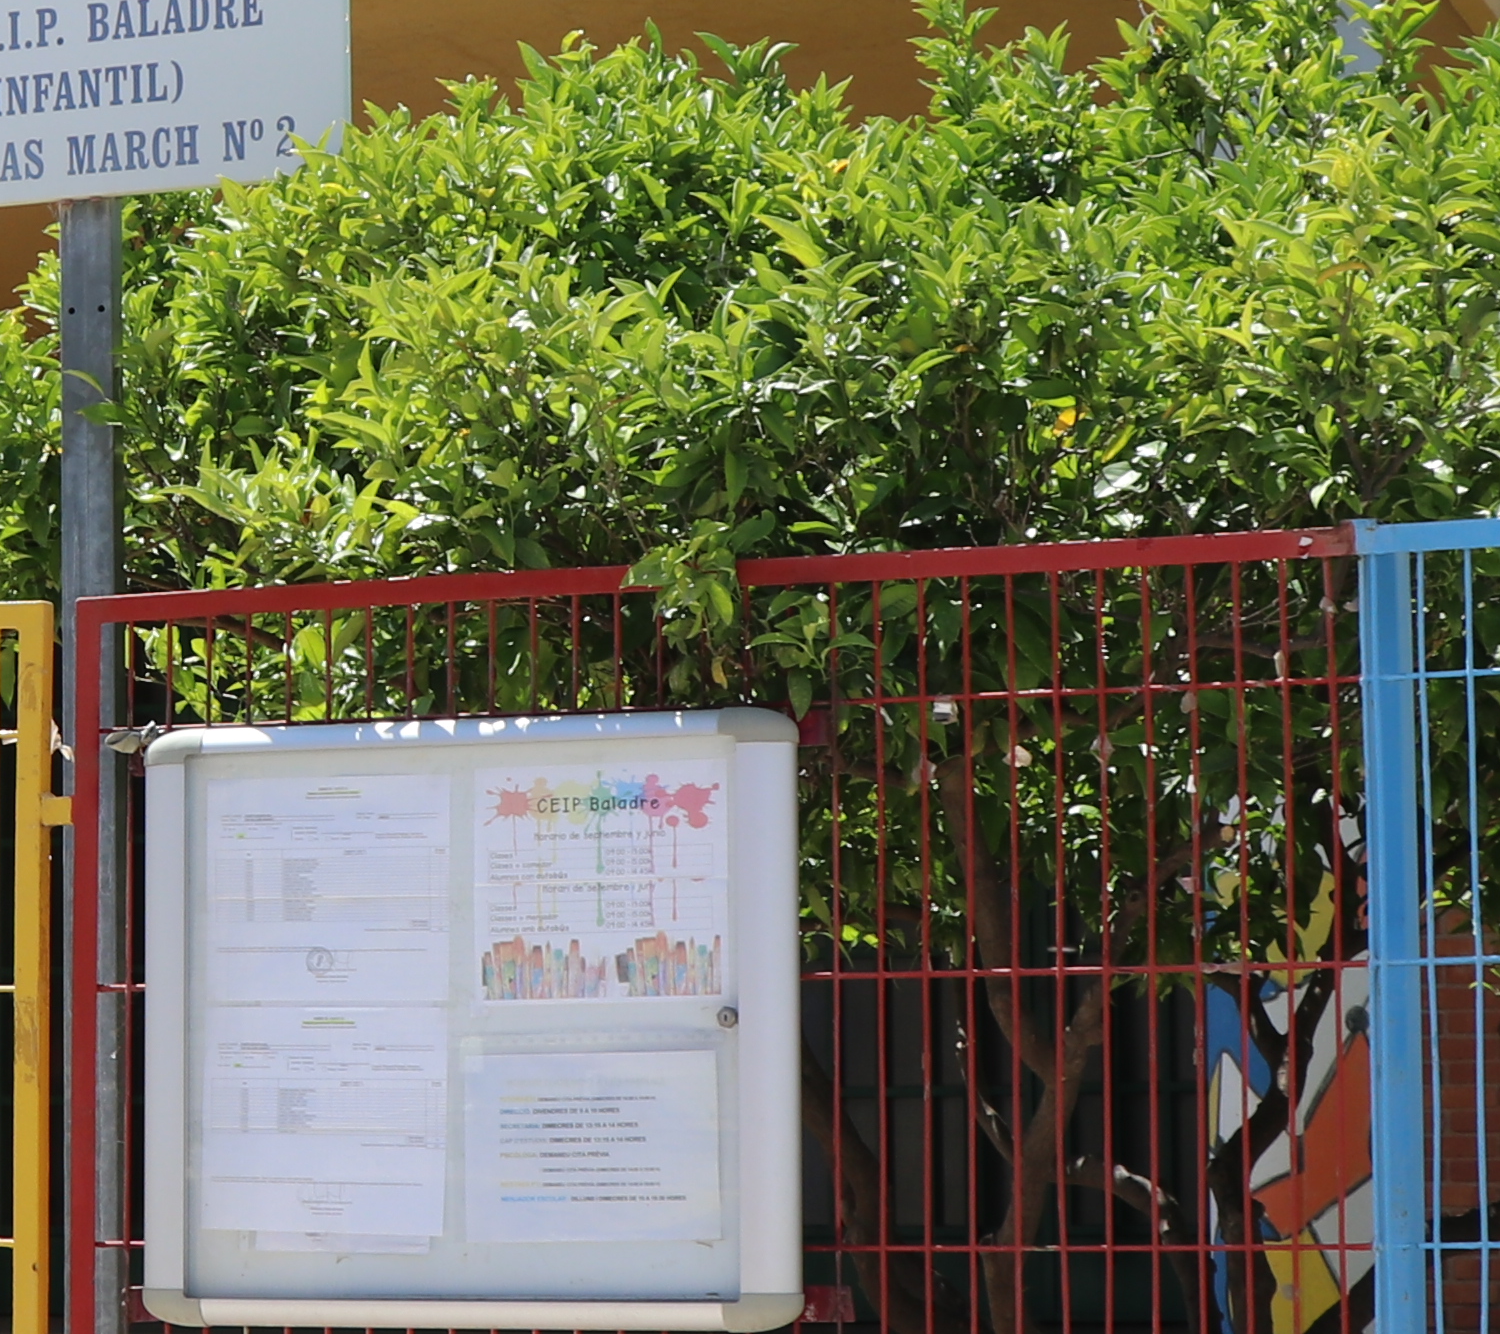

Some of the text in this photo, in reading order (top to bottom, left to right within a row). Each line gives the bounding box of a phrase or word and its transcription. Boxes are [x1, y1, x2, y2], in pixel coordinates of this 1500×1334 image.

[66, 124, 200, 176] MARCH
[275, 115, 296, 158] 2
[537, 794, 661, 814] CEIP Baladre
[569, 831, 581, 840] de
[542, 885, 571, 893] Horari
[573, 884, 584, 893] de
